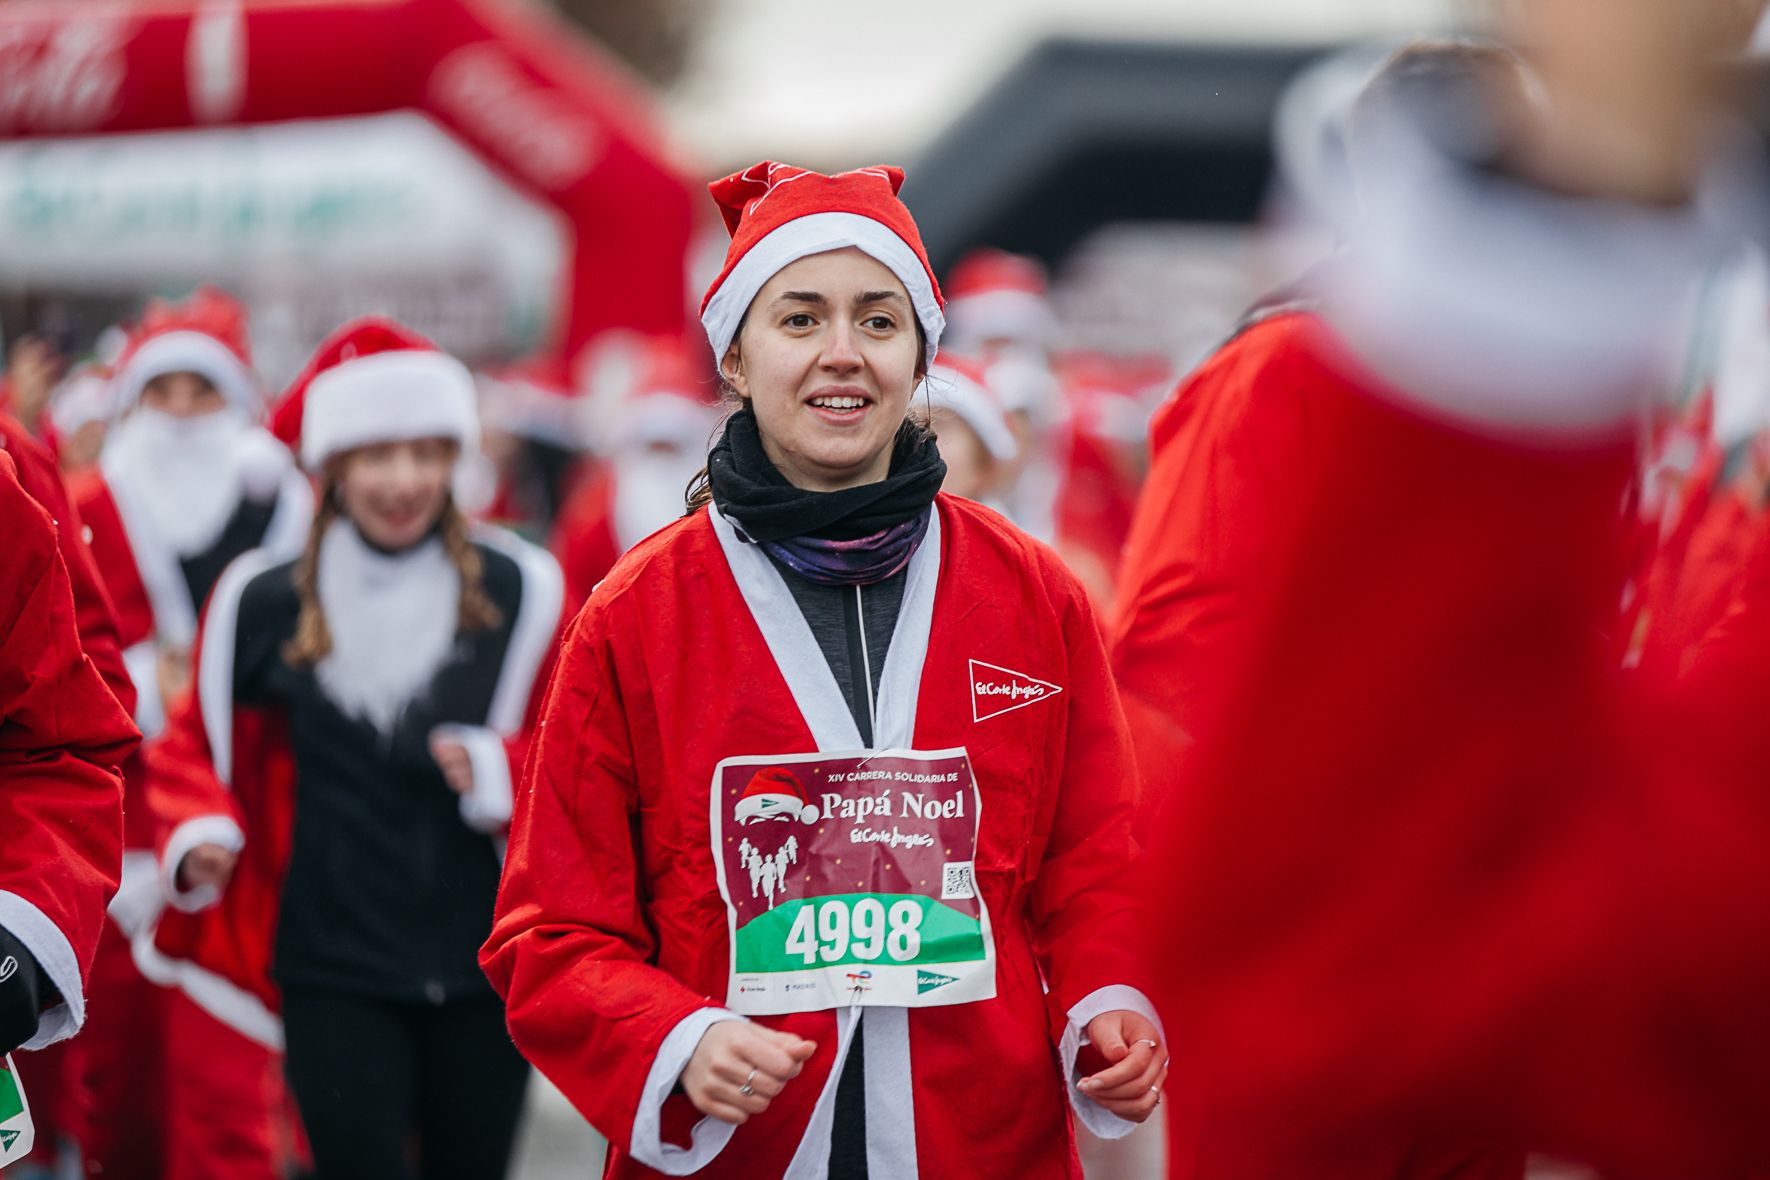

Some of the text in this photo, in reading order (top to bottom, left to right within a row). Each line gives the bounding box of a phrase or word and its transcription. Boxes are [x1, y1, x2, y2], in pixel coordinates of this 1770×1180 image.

[828, 771, 959, 784] XIV CARRERA SOLIDARIA DE
[820, 789, 965, 824] Papá Noel
[785, 898, 923, 965] 4998
